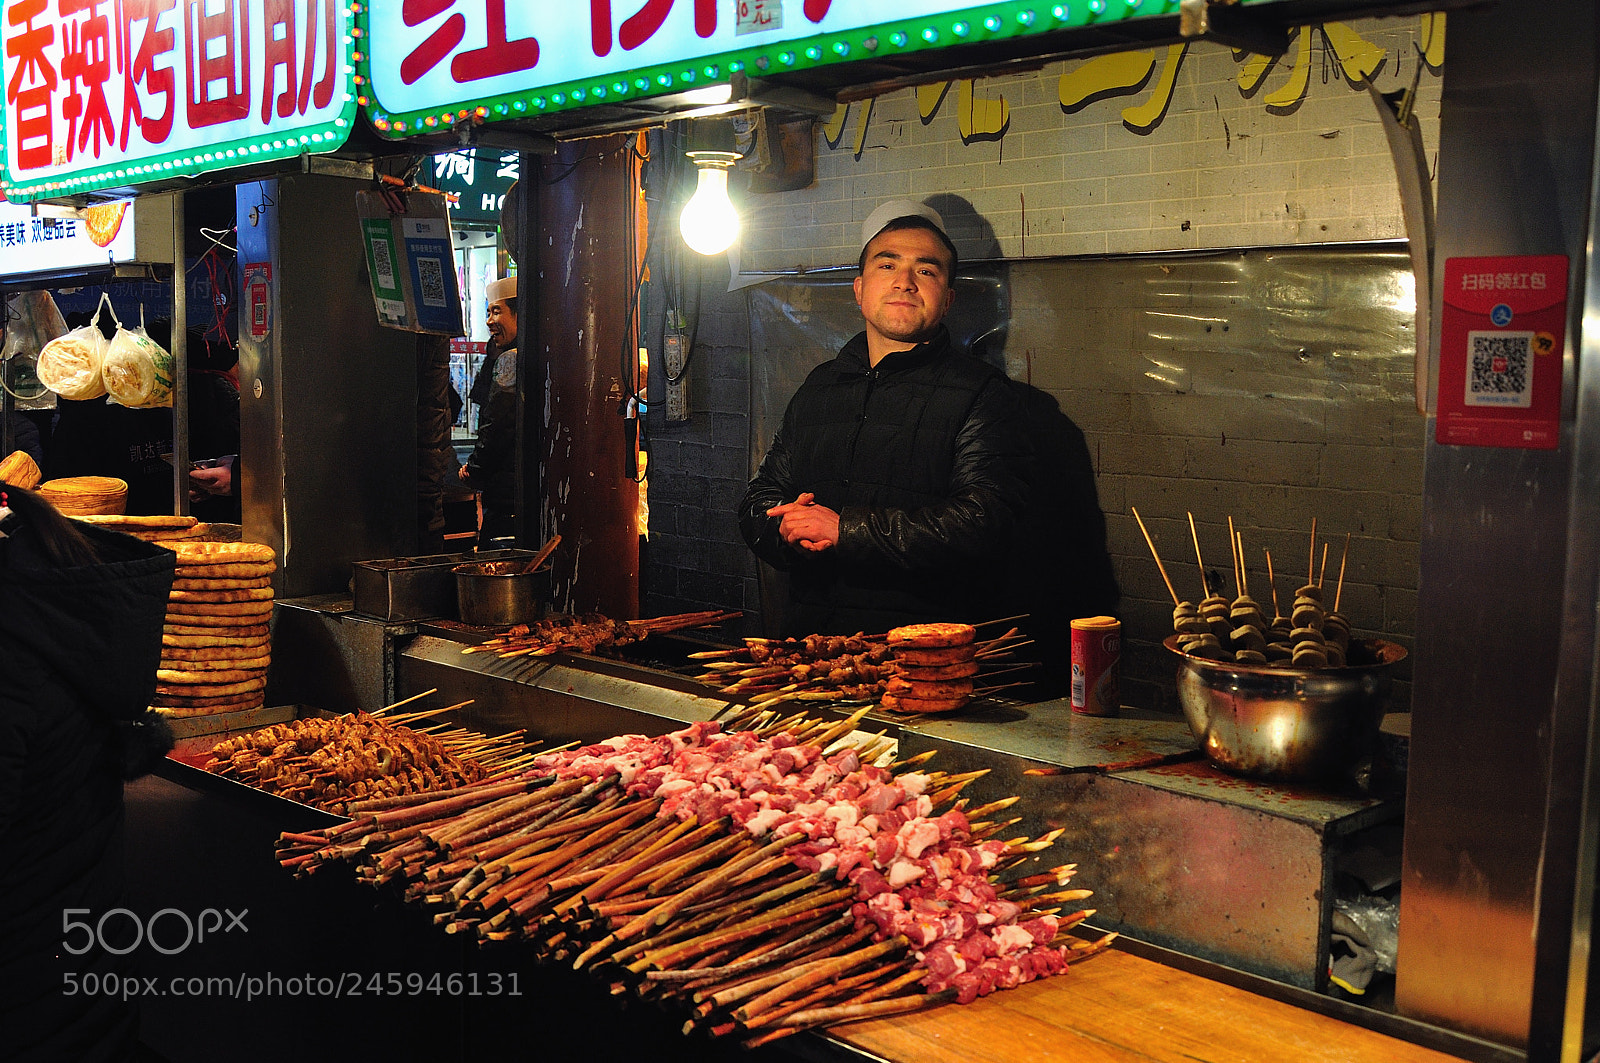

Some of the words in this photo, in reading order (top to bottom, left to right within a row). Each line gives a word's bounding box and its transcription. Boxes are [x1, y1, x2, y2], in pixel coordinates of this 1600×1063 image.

[1461, 272, 1547, 291] 扫码领红包
